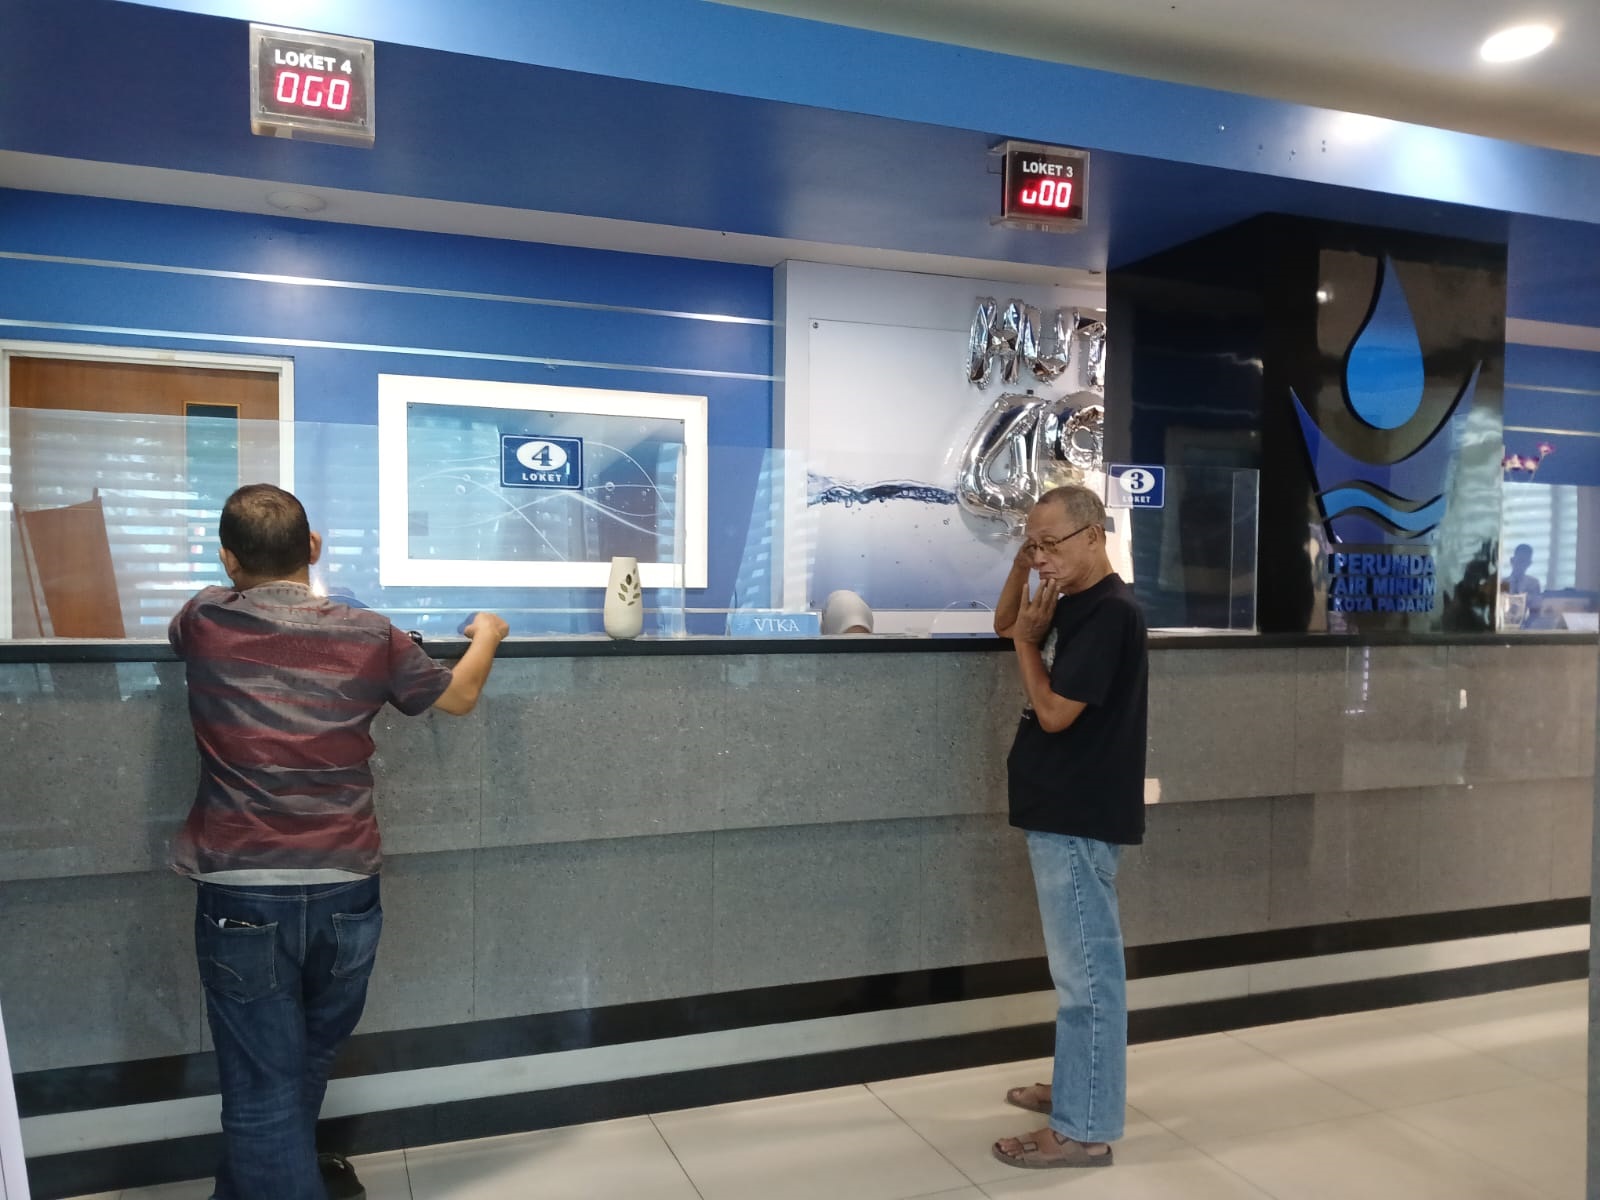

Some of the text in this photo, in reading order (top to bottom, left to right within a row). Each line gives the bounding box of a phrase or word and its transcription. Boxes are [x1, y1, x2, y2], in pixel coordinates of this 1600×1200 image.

[274, 49, 353, 75] LOKET 4
[1022, 160, 1074, 178] LOKET 3
[531, 445, 553, 467] 4
[521, 472, 562, 482] LOKET
[1130, 471, 1145, 490] 3
[1122, 495, 1151, 503] LOKET
[1330, 552, 1436, 575] PERUMDA
[1331, 576, 1437, 596] AIR MINUM
[1331, 597, 1436, 613] KOTA PADANG
